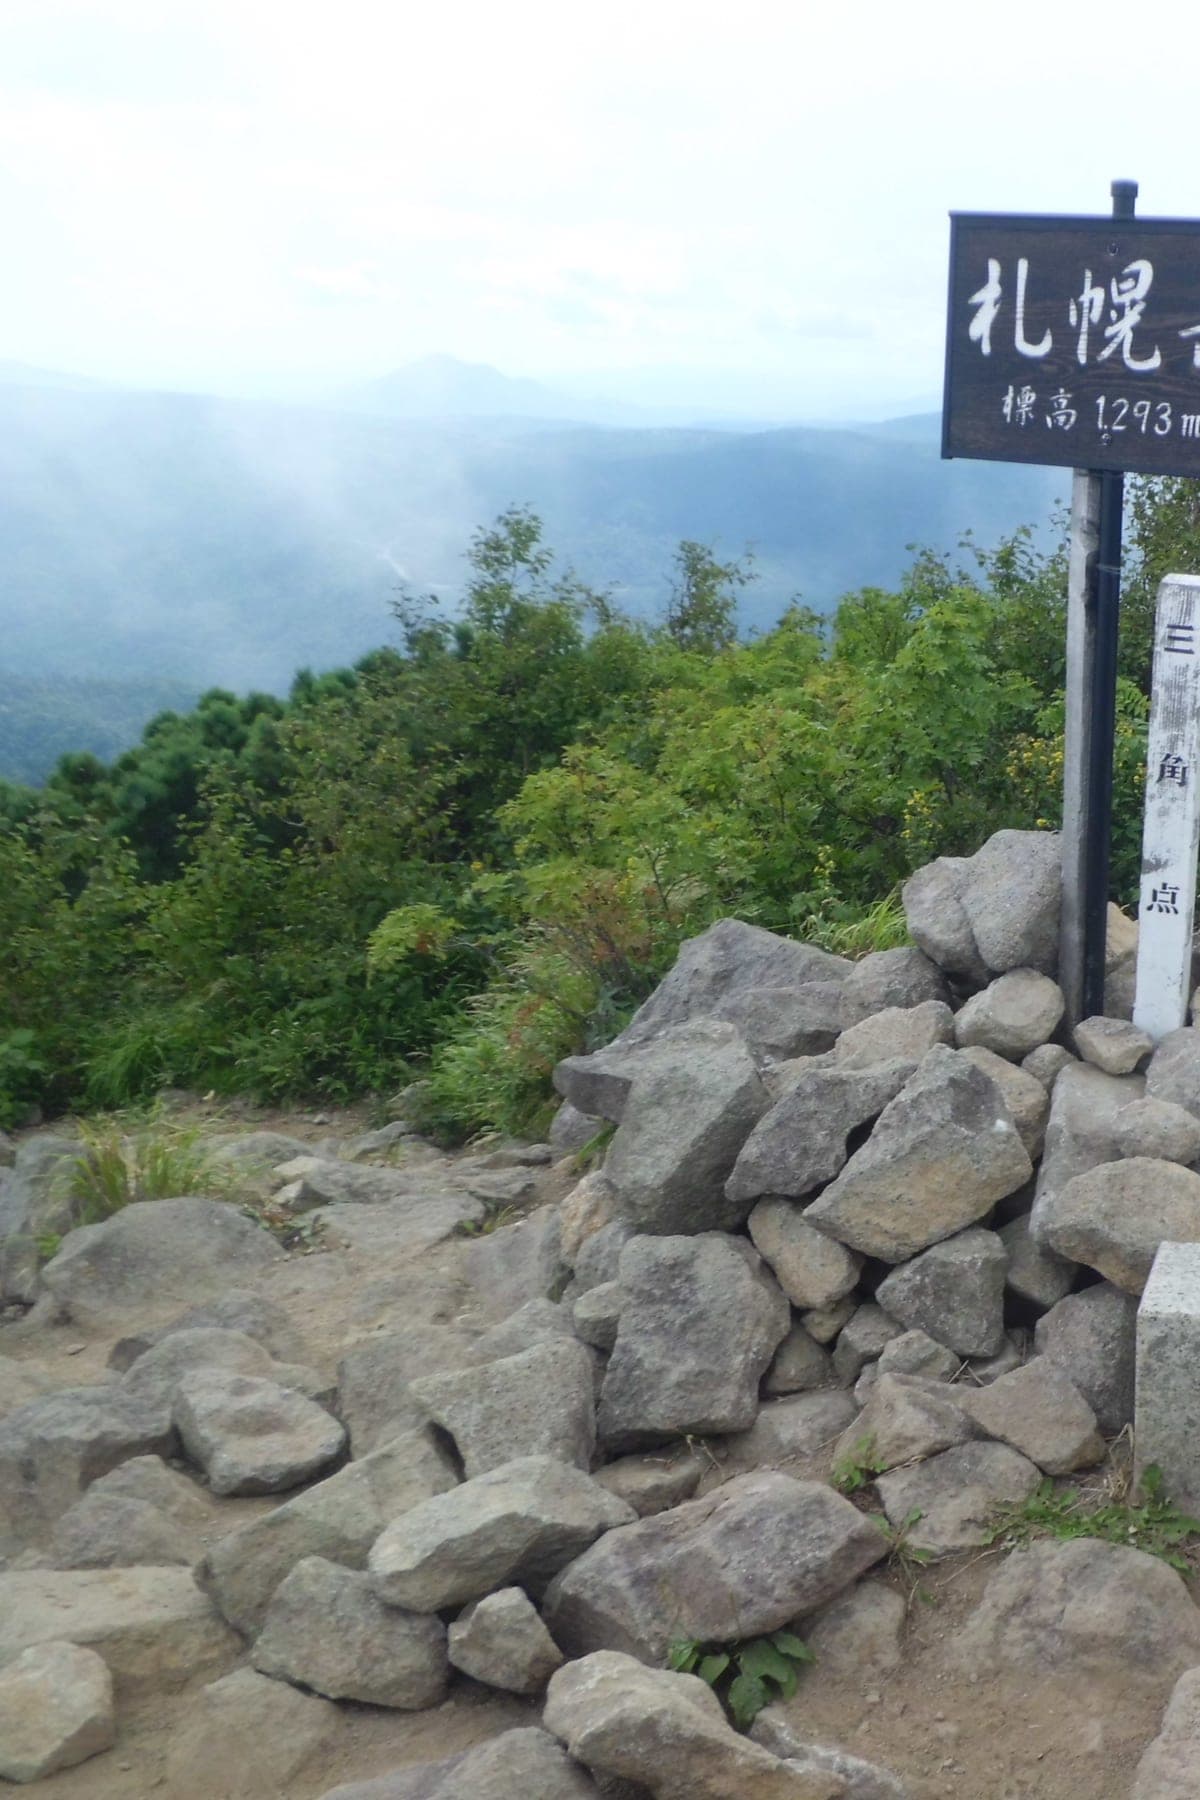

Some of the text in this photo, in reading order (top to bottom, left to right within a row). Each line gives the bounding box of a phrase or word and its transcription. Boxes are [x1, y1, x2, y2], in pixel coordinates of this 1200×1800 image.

[1002, 385, 1077, 430] 標高
[1147, 623, 1194, 914] 三角点
